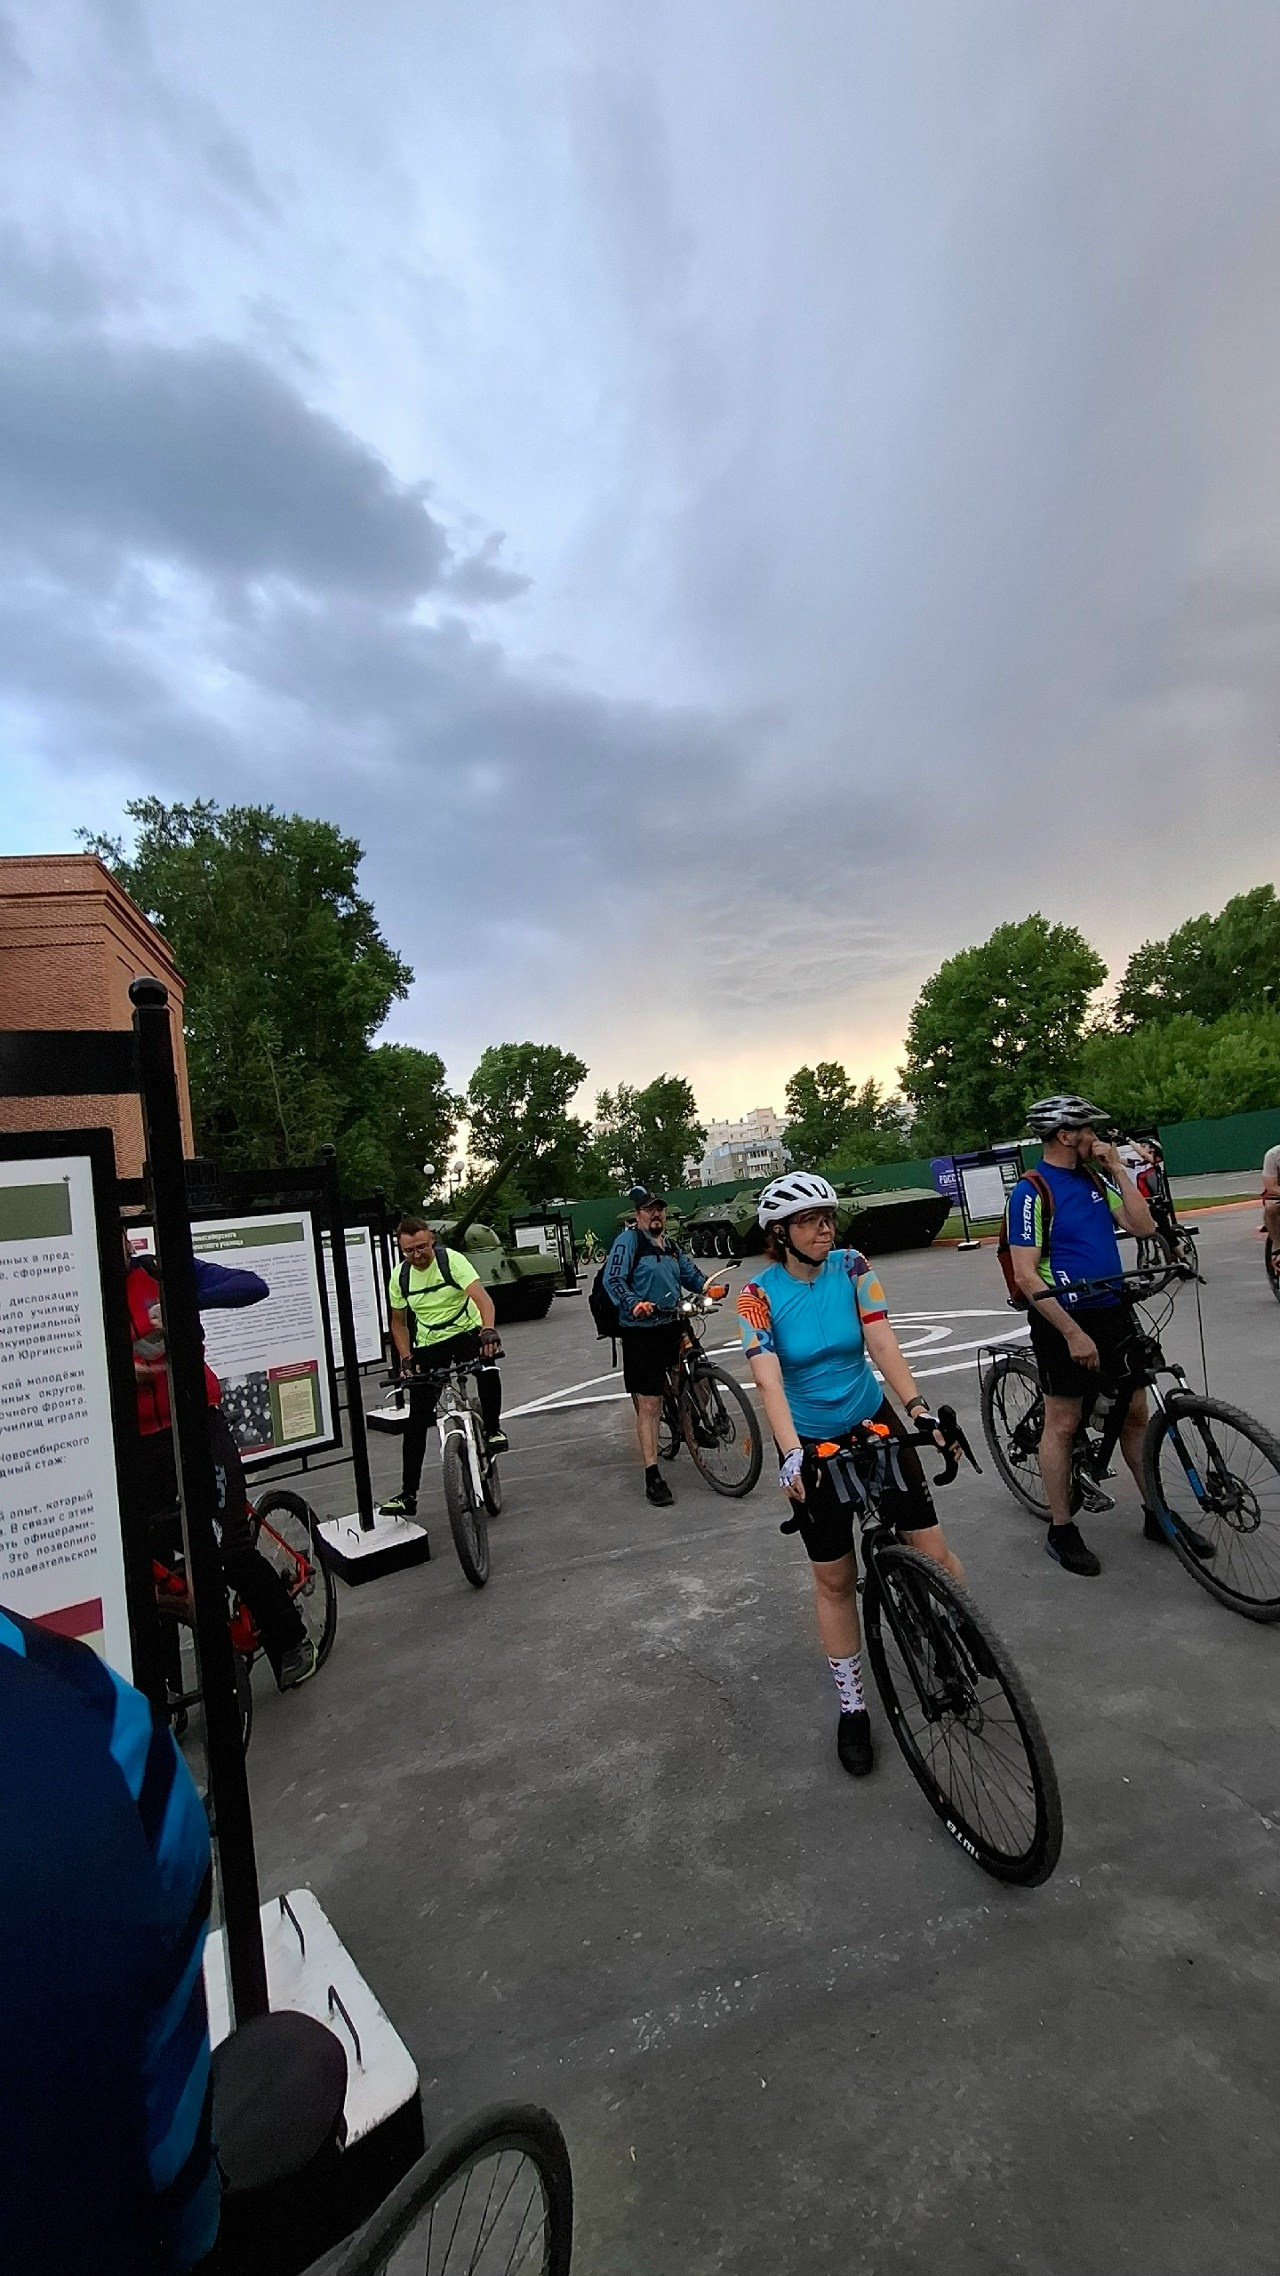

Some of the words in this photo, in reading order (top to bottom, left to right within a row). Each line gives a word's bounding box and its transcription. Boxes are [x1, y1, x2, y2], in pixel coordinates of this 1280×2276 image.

[1023, 1194, 1033, 1234] STERN
[33, 1255, 39, 1263] в
[42, 1251, 75, 1263] пред-
[13, 1264, 76, 1279] сформиро-
[9, 1290, 79, 1307] дислокации
[0, 1311, 24, 1321] ило
[30, 1303, 80, 1319] училищу
[19, 1340, 83, 1360] Юргинский
[27, 1369, 85, 1386] молодёжи
[47, 1409, 88, 1424] играли
[46, 1489, 93, 1510] который
[10, 1523, 19, 1534] В
[22, 1516, 55, 1531] связи
[59, 1513, 65, 1521] с
[68, 1505, 94, 1519] этим
[24, 1521, 95, 1546] офицерами-
[8, 1551, 29, 1564] Это
[36, 1533, 97, 1556] позволило
[0, 1547, 97, 1581] подавательском
